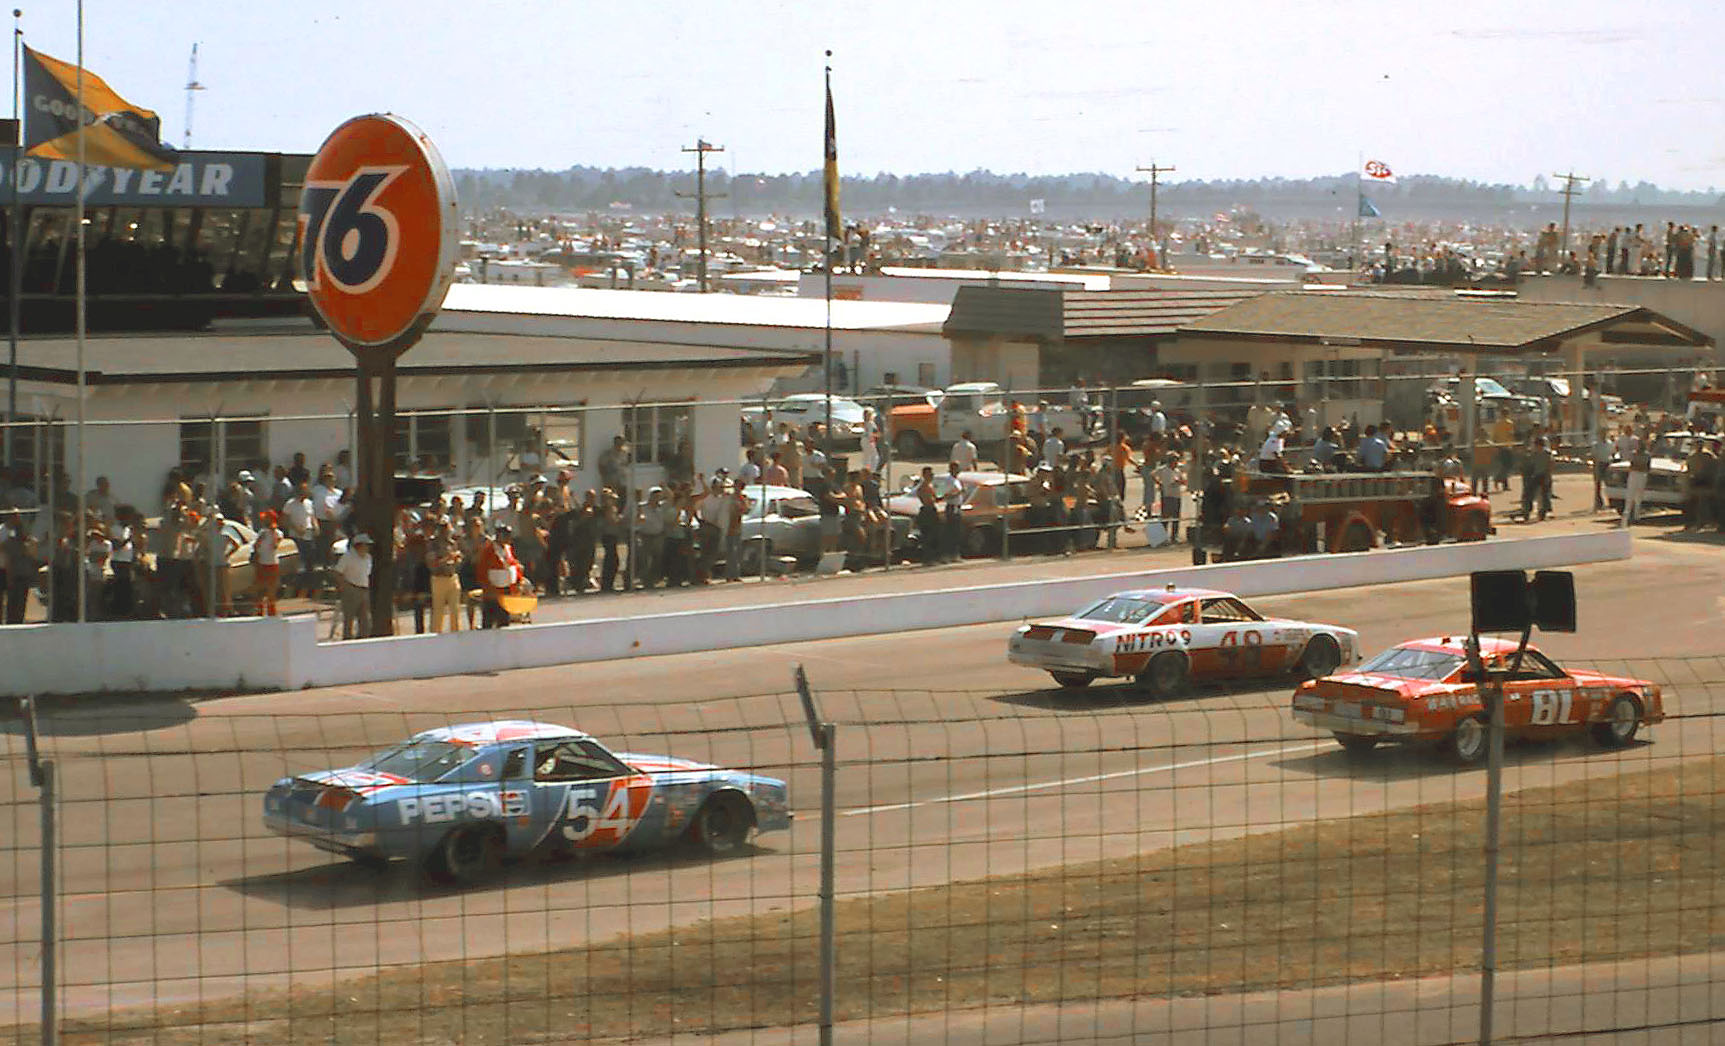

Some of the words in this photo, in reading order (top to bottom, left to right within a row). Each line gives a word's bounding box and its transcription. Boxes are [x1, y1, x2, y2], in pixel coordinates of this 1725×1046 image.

[0, 158, 234, 196] ODYEAR
[298, 165, 410, 295] 76
[1531, 690, 1579, 725] 81
[397, 792, 502, 825] PEPSI
[562, 787, 635, 841] 54
